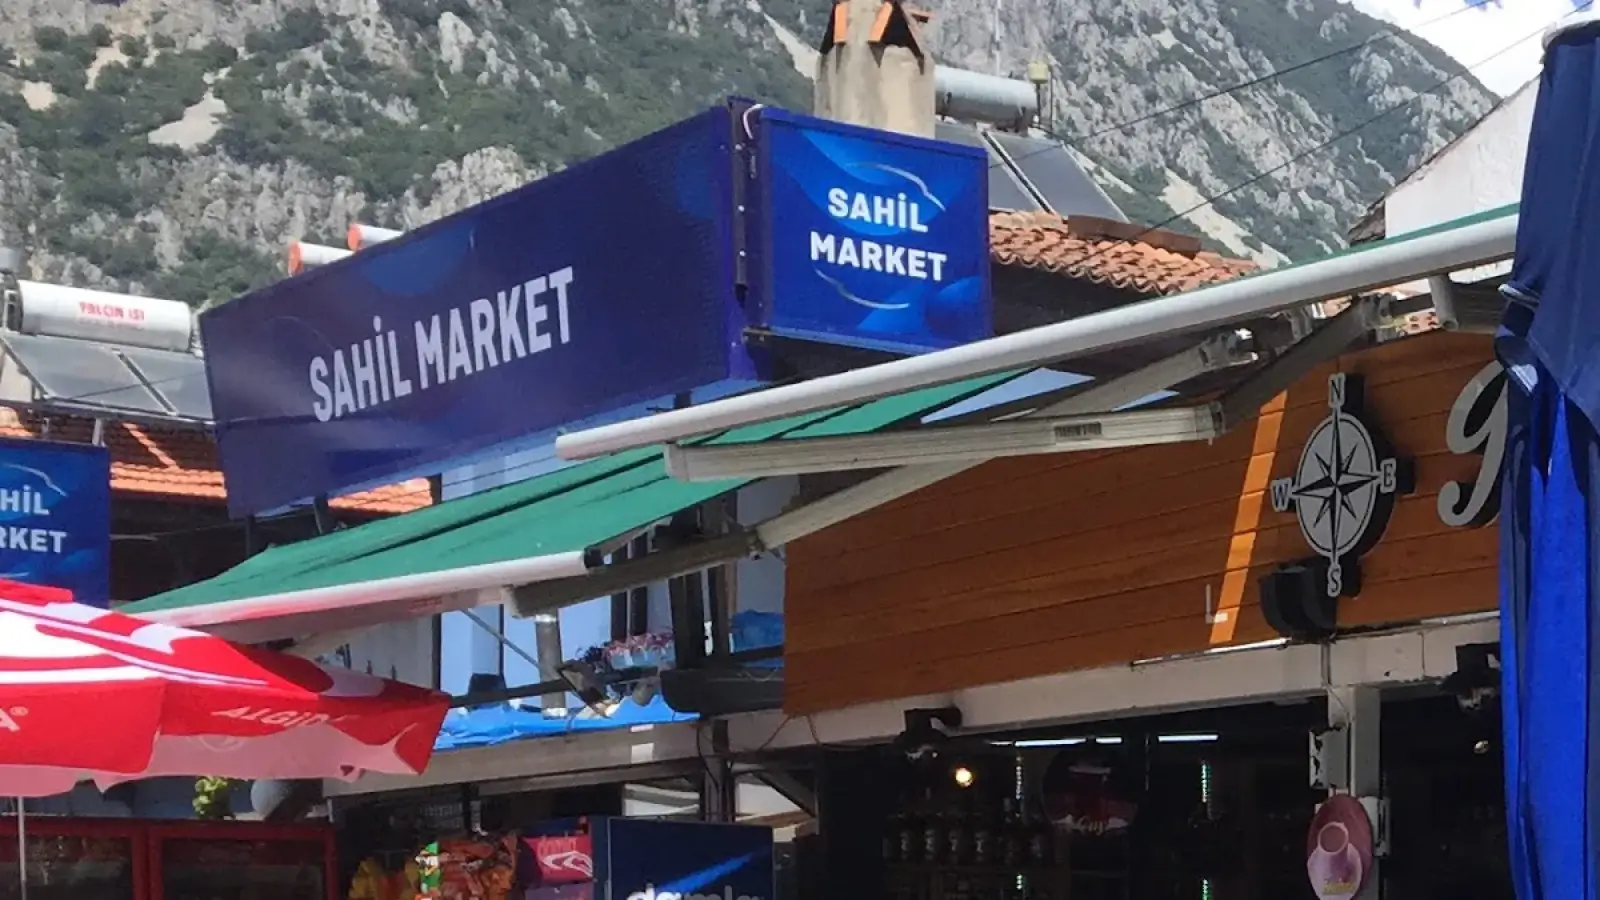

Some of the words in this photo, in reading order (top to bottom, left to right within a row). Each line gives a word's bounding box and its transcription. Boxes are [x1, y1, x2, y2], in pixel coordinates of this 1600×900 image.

[828, 187, 928, 233] SAHİL
[810, 231, 947, 281] MARKET
[309, 315, 412, 423] SAHİL
[414, 265, 573, 390] MARKET
